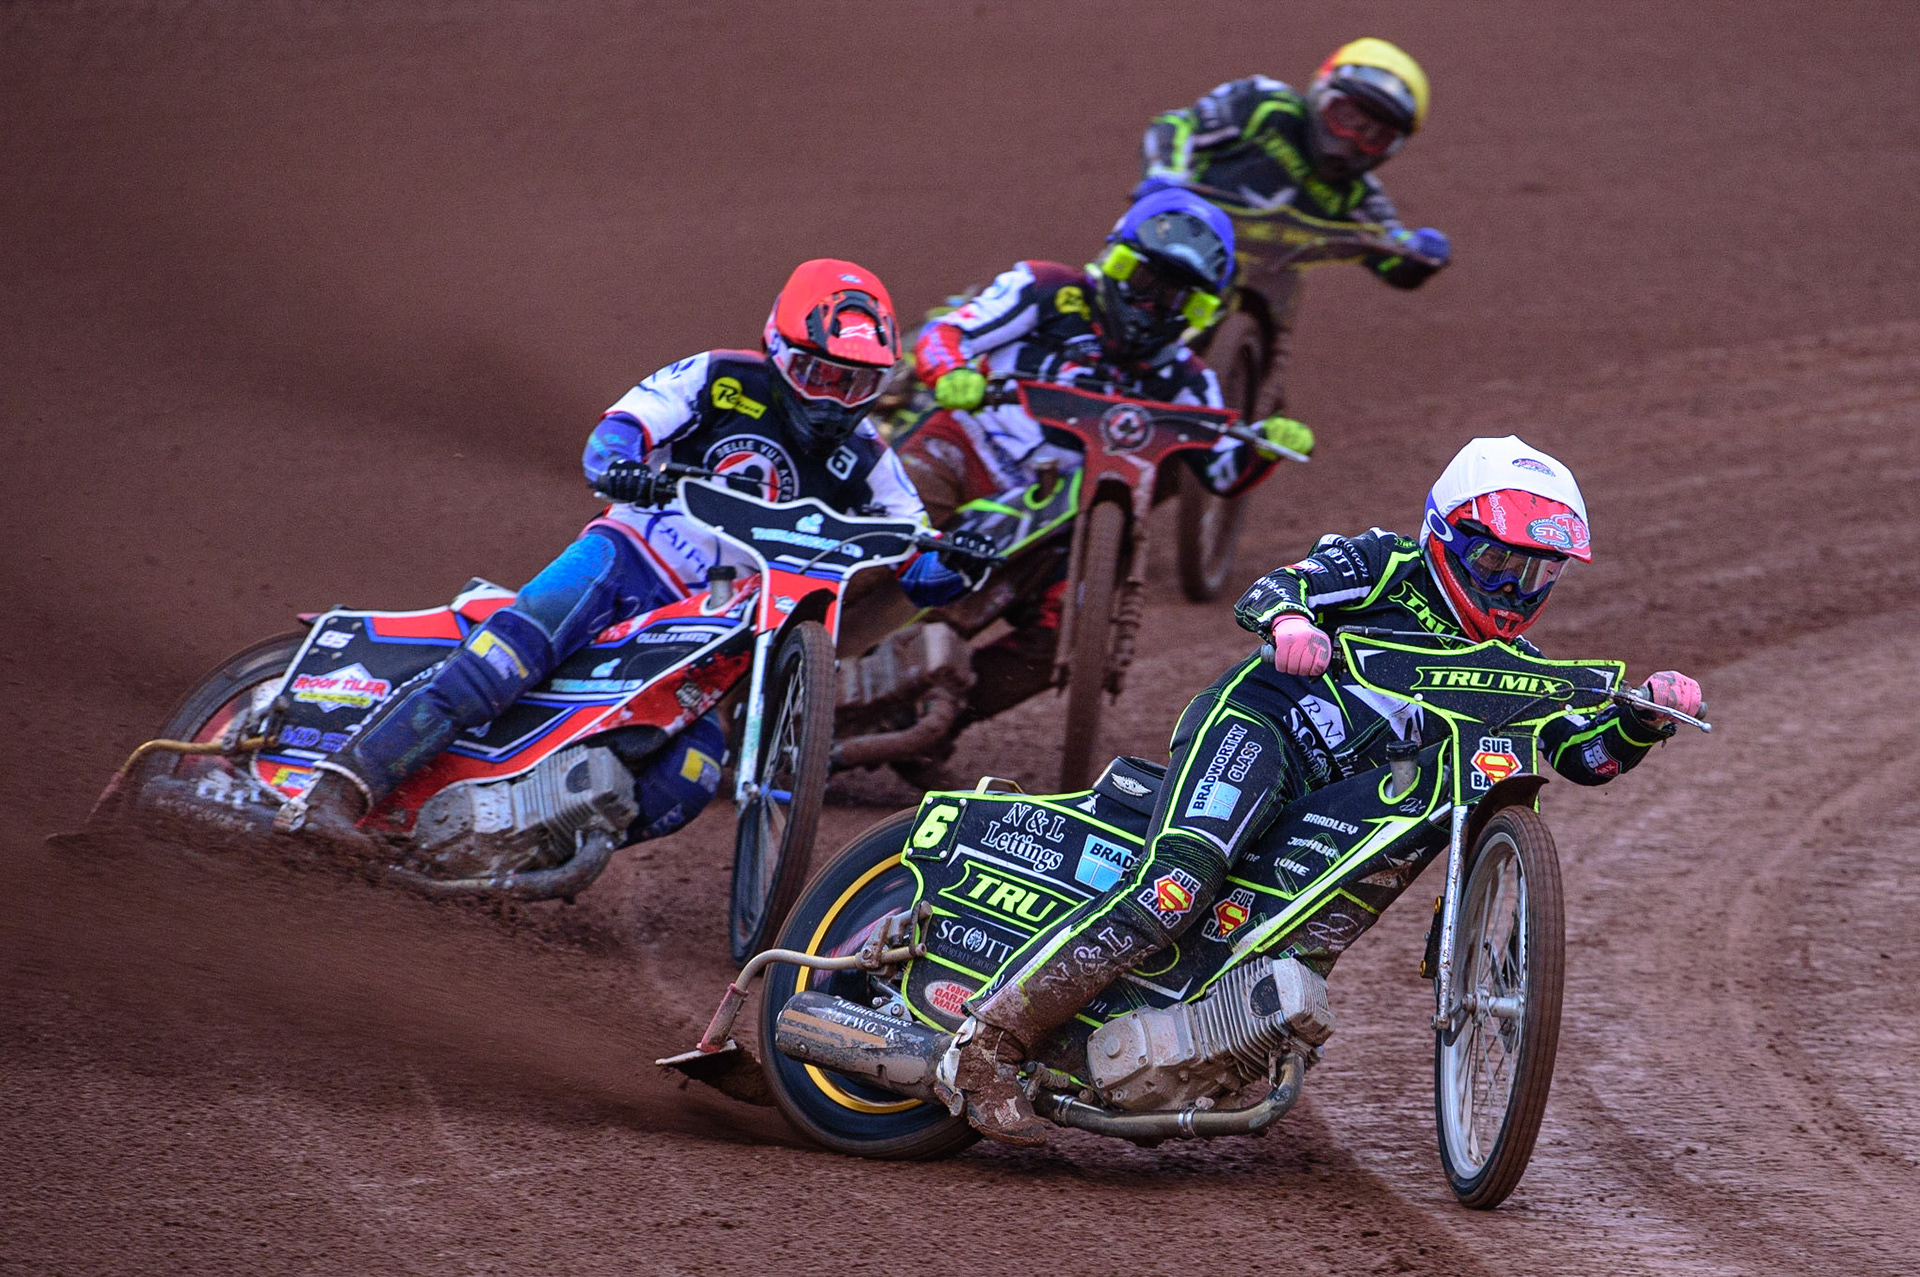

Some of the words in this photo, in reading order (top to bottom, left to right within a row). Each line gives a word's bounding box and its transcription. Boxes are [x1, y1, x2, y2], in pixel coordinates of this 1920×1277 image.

[1534, 526, 1566, 541] STS
[342, 678, 387, 697] TILER
[1429, 670, 1494, 688] TRU
[1500, 674, 1564, 694] MIX
[1481, 739, 1510, 753] SUE
[1192, 723, 1248, 811] BRADWORTHY
[1228, 741, 1262, 782] GLASS
[912, 804, 958, 849] 6
[1002, 802, 1031, 827] N
[1026, 810, 1049, 836] &
[1046, 815, 1065, 843] L
[1302, 812, 1359, 835] BRADLEY
[981, 821, 1063, 872] Lettings
[1287, 836, 1341, 860] JOSHUA
[1274, 857, 1310, 876] LUKE
[1171, 869, 1200, 893] SUE
[968, 873, 1058, 923] TRU
[1139, 890, 1181, 927] BAKER
[1229, 890, 1253, 908] SUE
[936, 920, 1014, 963] SCOTT
[1098, 926, 1133, 957] L
